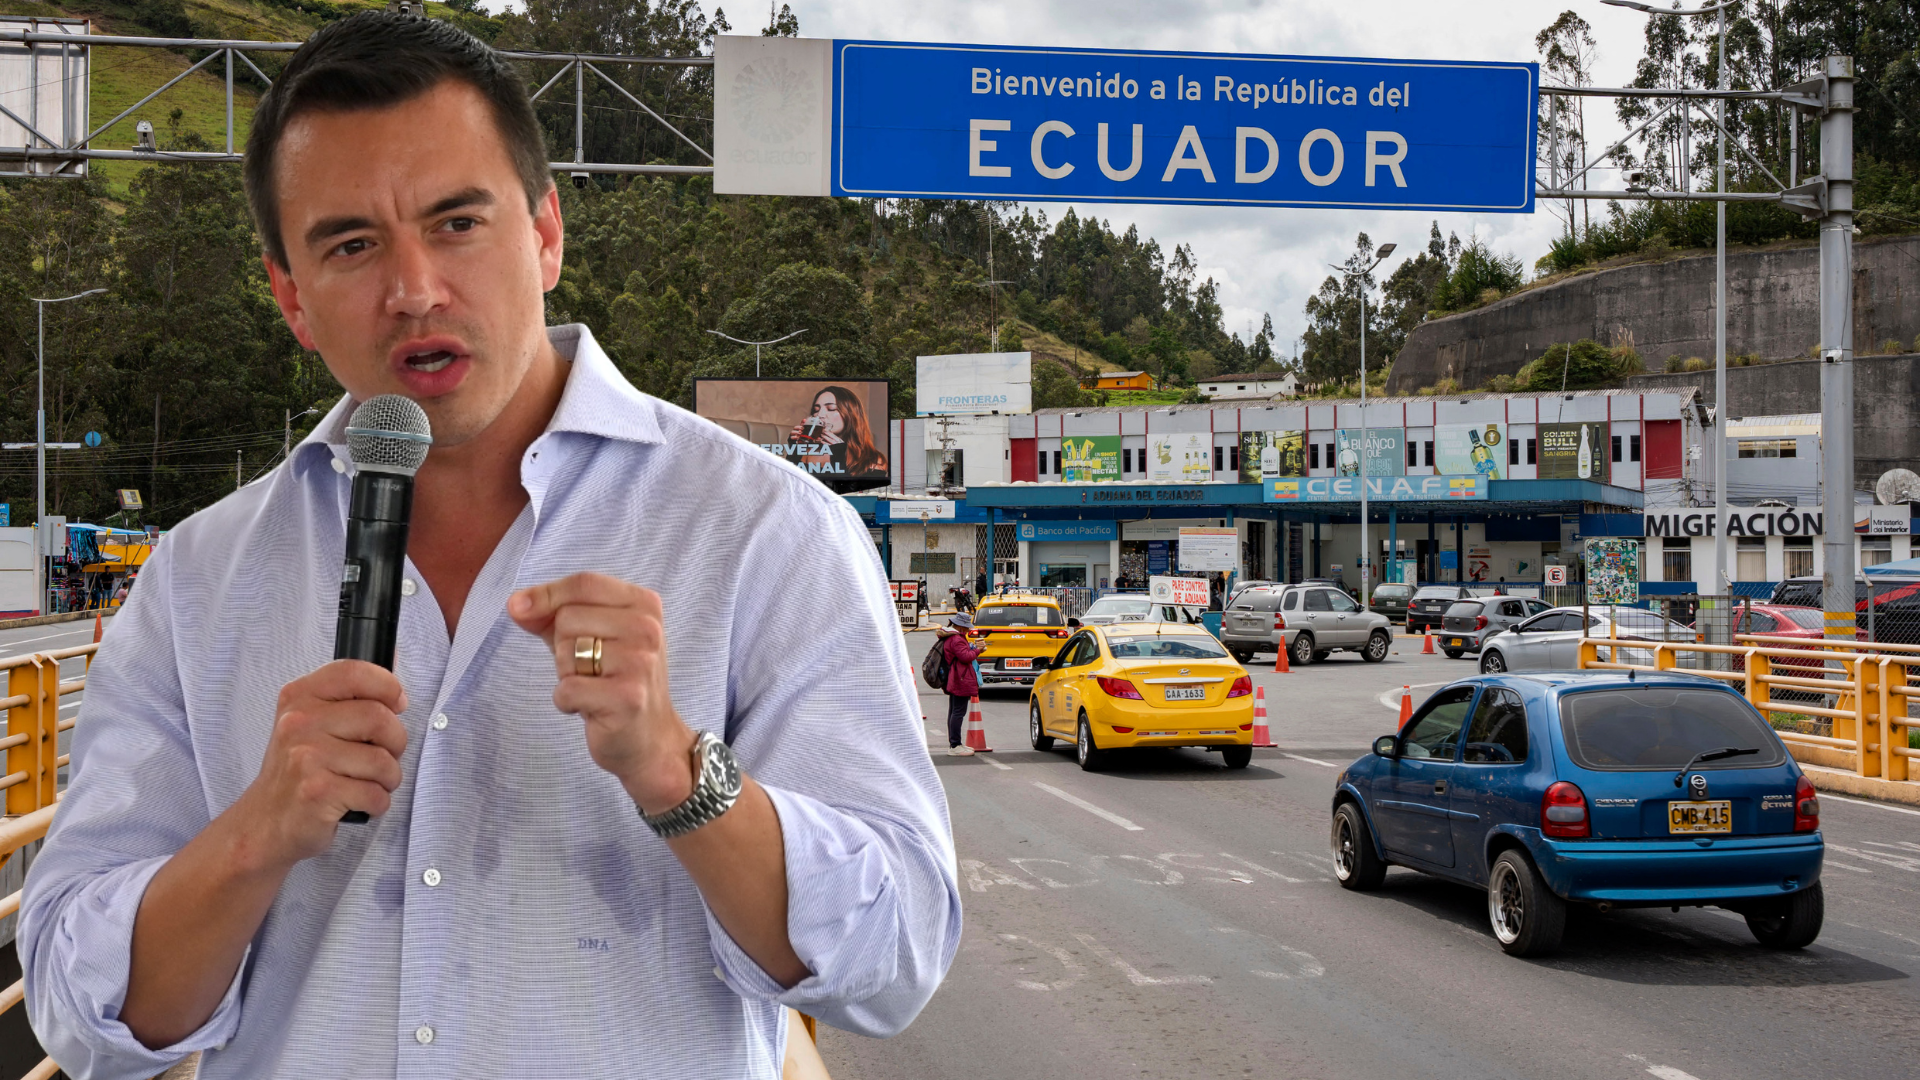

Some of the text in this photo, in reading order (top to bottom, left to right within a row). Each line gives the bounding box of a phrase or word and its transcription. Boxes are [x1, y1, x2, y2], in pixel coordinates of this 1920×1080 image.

[970, 67, 1410, 109] Bienvenido a la República del
[968, 118, 1409, 188] ECUADOR
[939, 395, 1007, 404] FRONTERAS
[1369, 431, 1377, 439] EL
[1351, 438, 1395, 450] BLANCO
[1543, 438, 1577, 447] BULL
[758, 444, 833, 456] ERVEZA
[1367, 449, 1382, 458] QUE
[798, 462, 845, 474] ANAL
[1306, 477, 1442, 495] CENAF
[1093, 490, 1203, 501] ADUANA DEL ECUADOR
[1646, 508, 1823, 537] MIGRACIÓN
[1038, 526, 1111, 535] Banco del Pacífico
[1172, 580, 1207, 593] PARE CONTROL
[1174, 593, 1207, 604] DE ADUANA
[1165, 688, 1204, 699] CAA-1633
[1672, 807, 1729, 825] CMB 415
[577, 938, 609, 950] DNA
